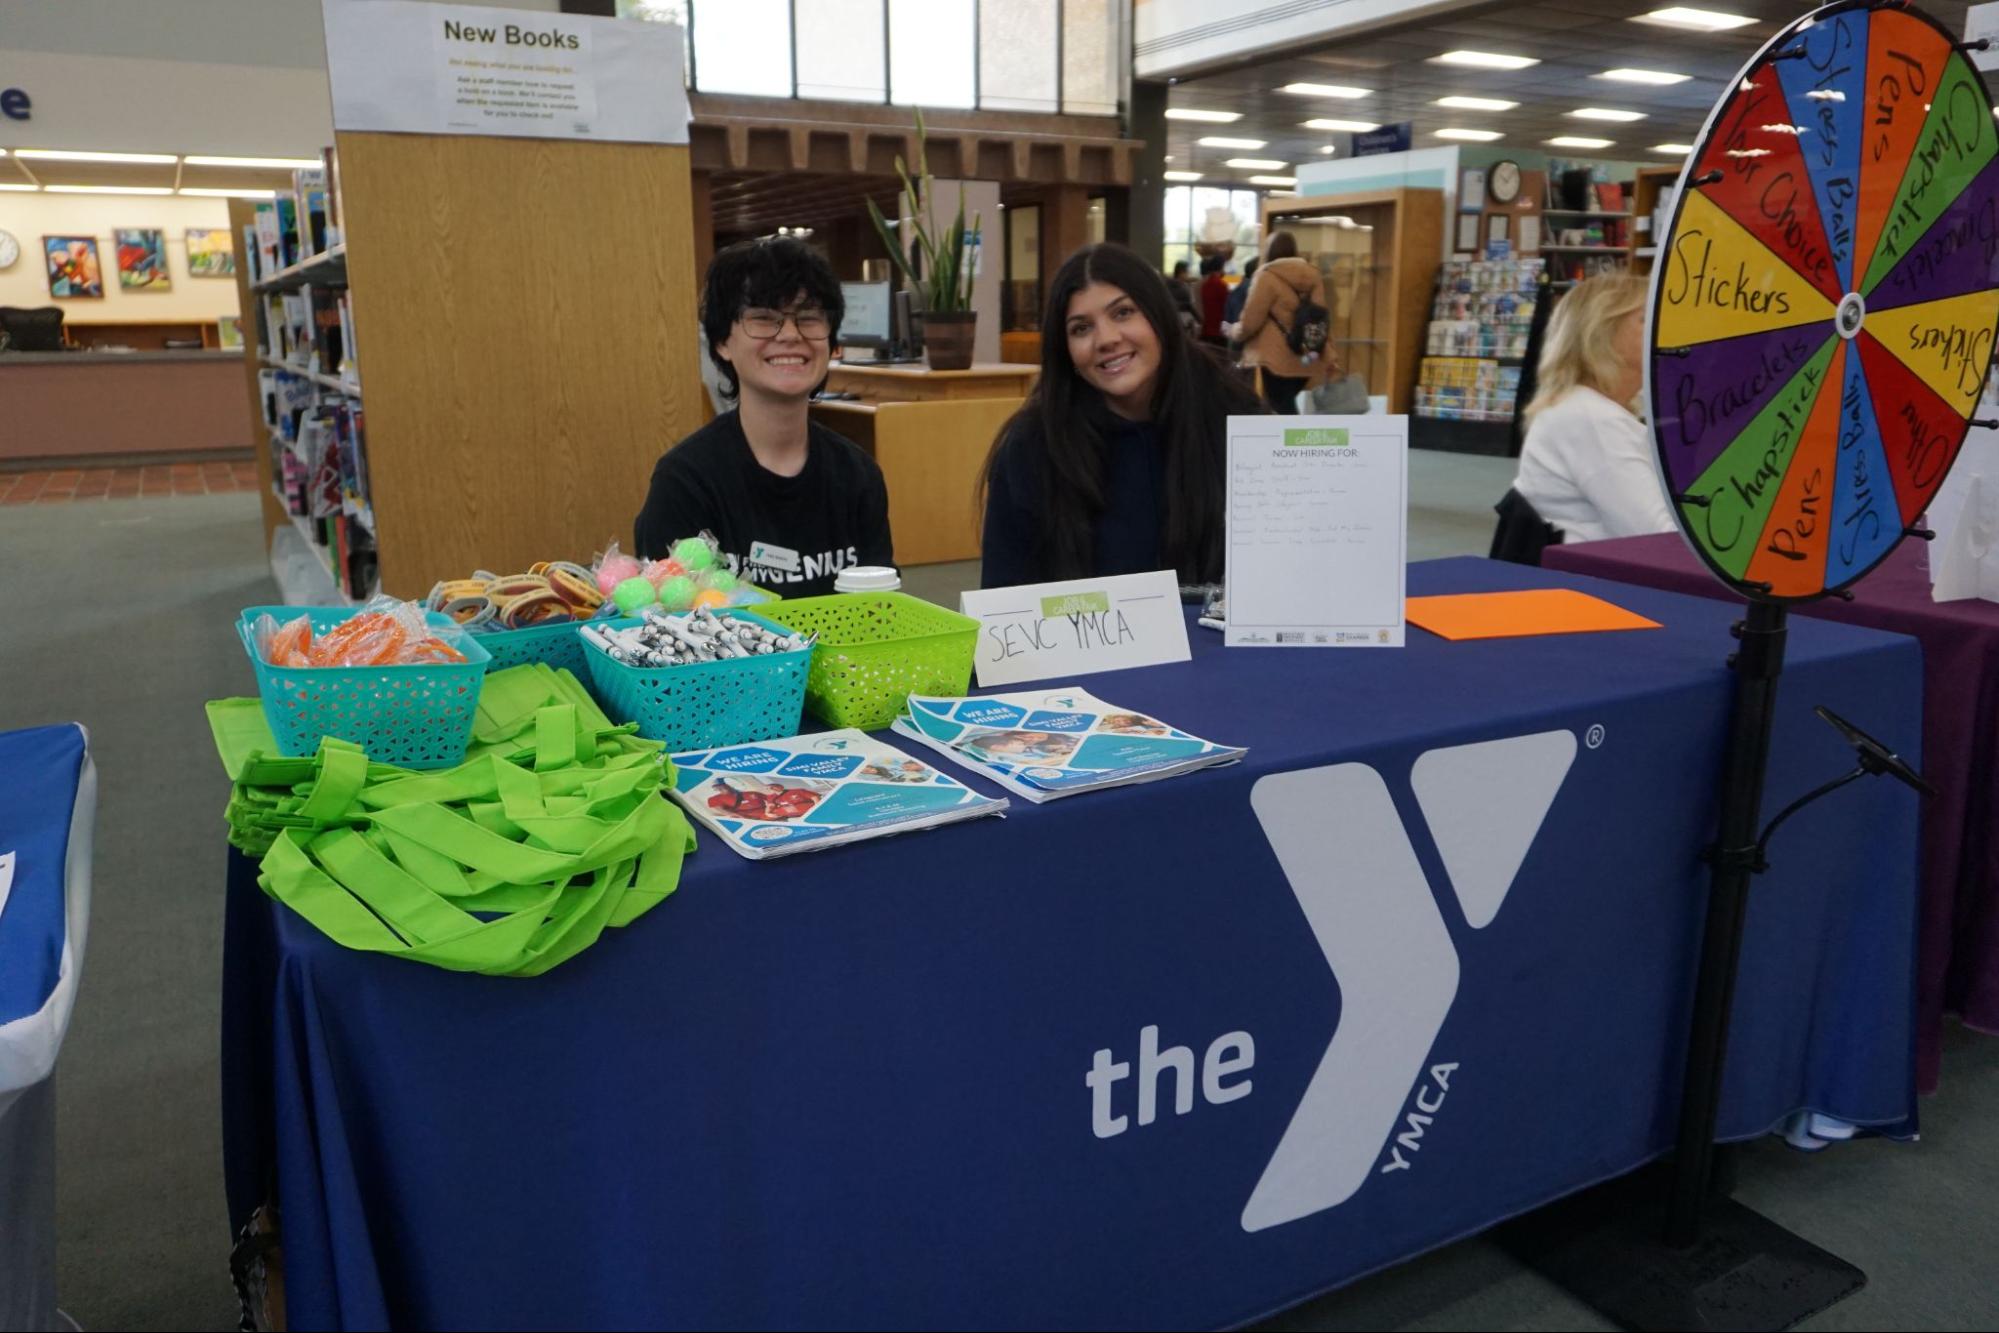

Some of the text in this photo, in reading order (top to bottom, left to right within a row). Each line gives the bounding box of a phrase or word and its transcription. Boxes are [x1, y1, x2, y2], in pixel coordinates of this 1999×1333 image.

[444, 20, 579, 49] New Books
[1875, 50, 1926, 163] Pens
[1880, 80, 1981, 259] Chapstick
[1667, 230, 1791, 316] Stickers
[1760, 172, 1829, 283] Choice
[1675, 338, 1809, 447] Bracelets
[1909, 323, 1990, 397] Stickers
[1272, 449, 1298, 458] NOW
[1299, 448, 1336, 458] HIRING
[1706, 366, 1821, 552] Chapstick
[1767, 467, 1823, 562] Pens
[1066, 609, 1135, 649] YMCA
[716, 751, 772, 765] WE ARE
[725, 757, 779, 770] HIRING
[1086, 1024, 1255, 1138] the
[1380, 1061, 1460, 1174] YMCA
